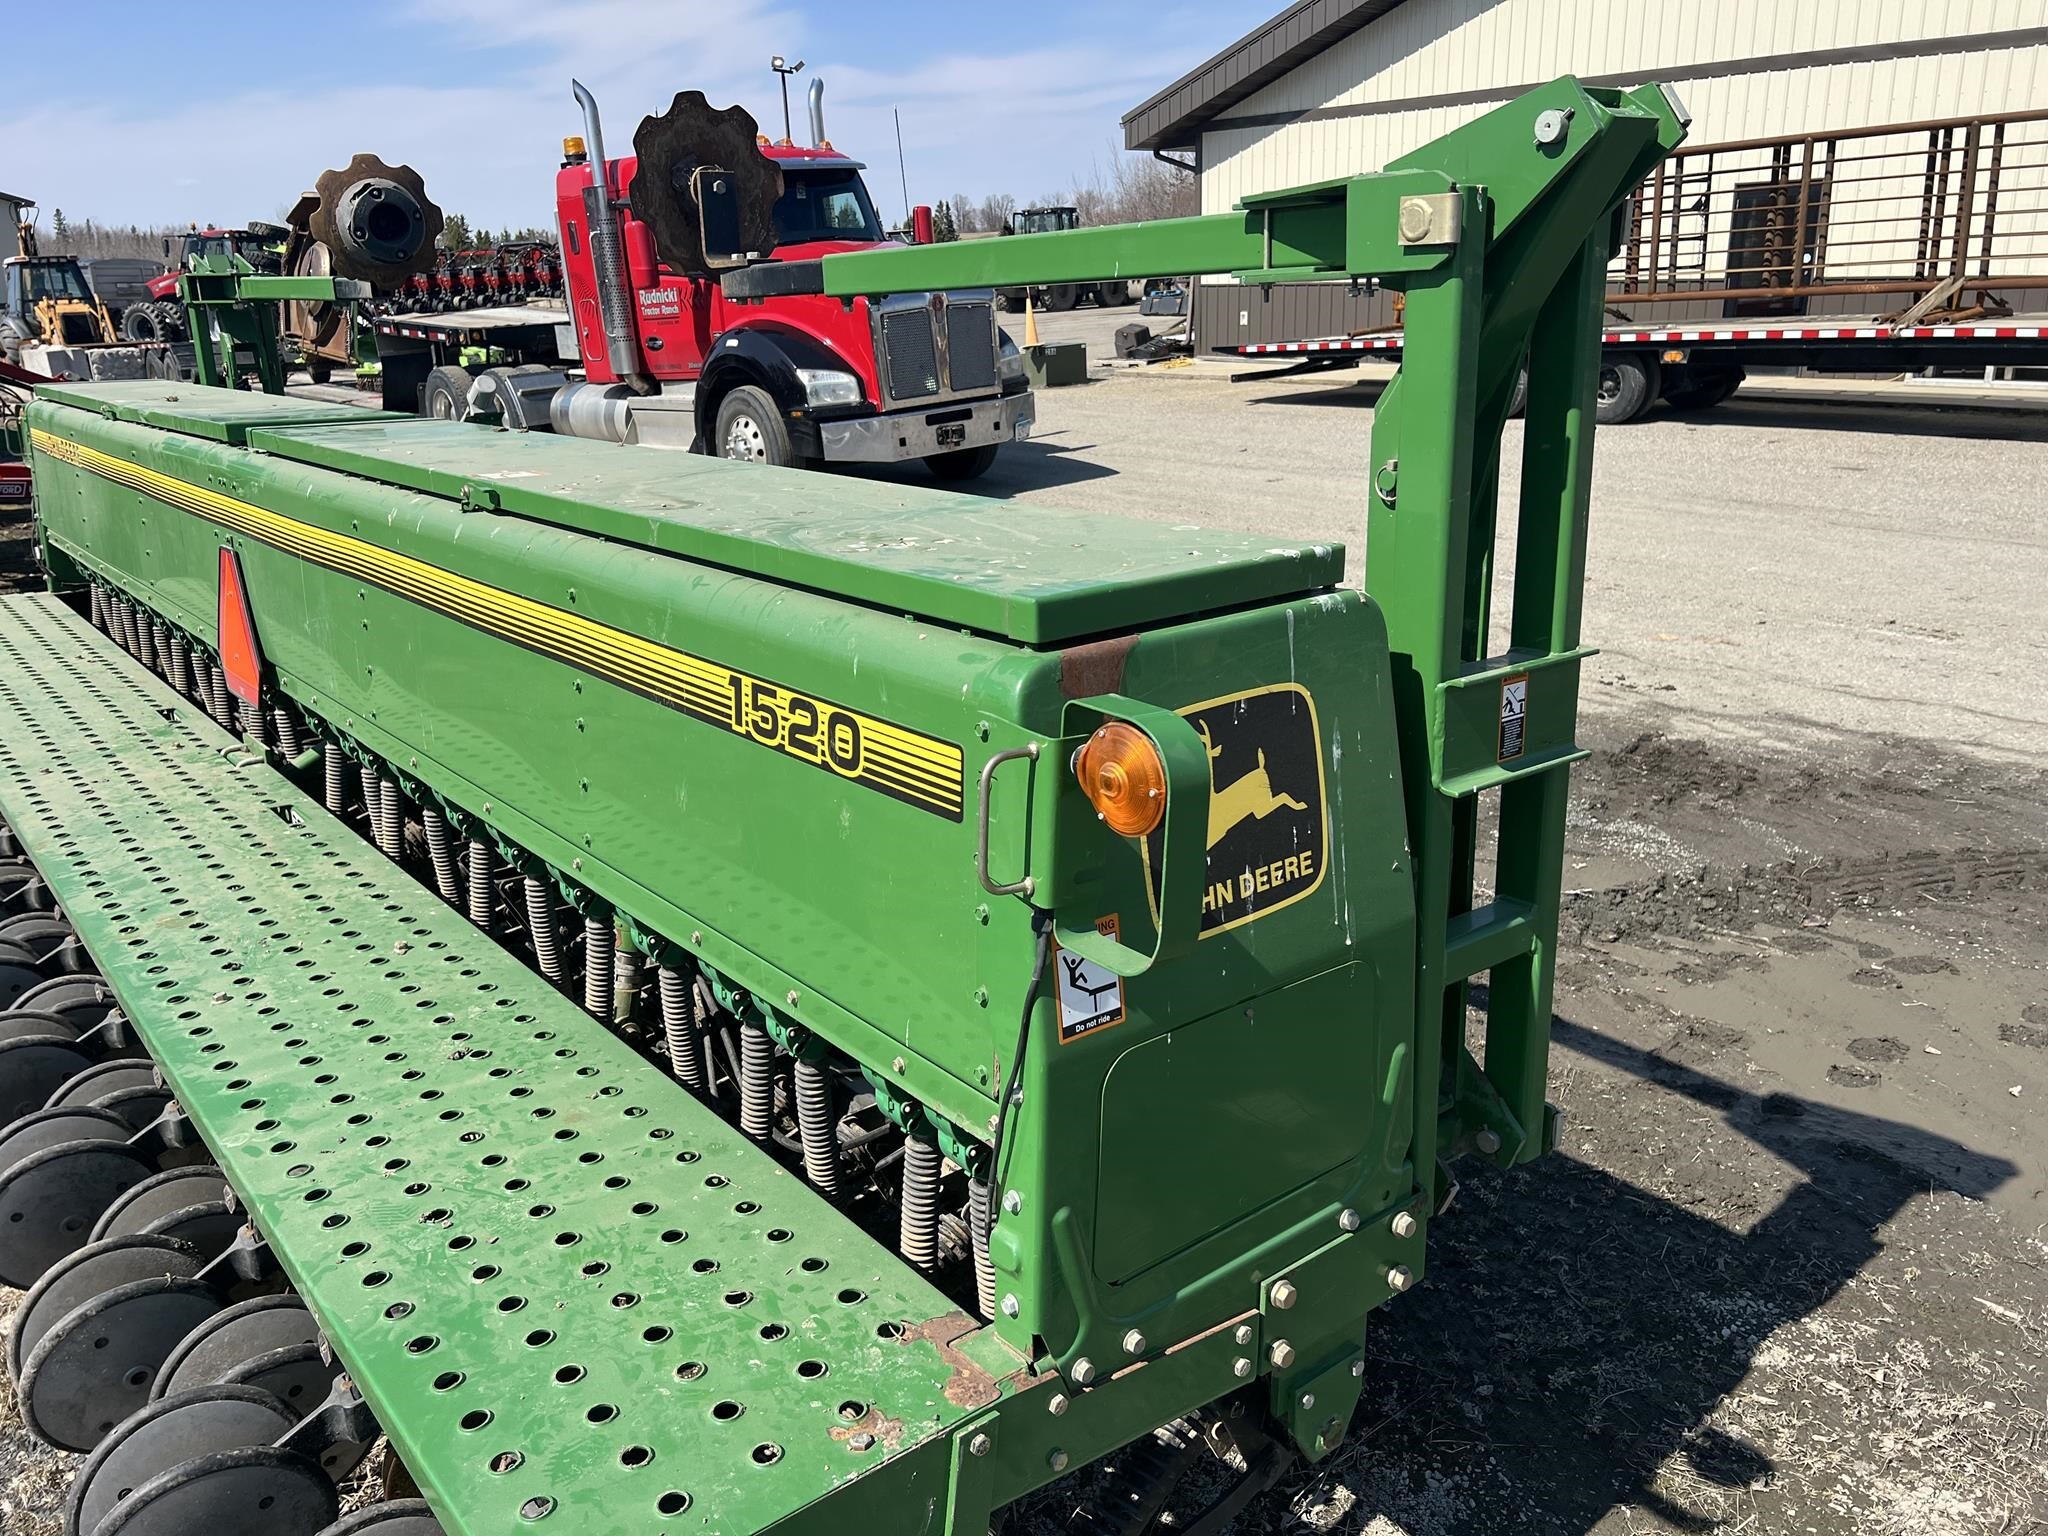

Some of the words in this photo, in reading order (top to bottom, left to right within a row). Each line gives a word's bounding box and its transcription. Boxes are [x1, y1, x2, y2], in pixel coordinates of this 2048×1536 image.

[639, 288, 678, 306] Rudnicki
[641, 307, 660, 316] Tractor
[661, 305, 679, 315] Ranch
[728, 674, 862, 776] 1520
[1201, 879, 1234, 914] HN
[1239, 850, 1314, 899] DEERE
[1075, 1024, 1085, 1033] Do
[1086, 1019, 1097, 1029] not
[1098, 1013, 1111, 1025] ride
